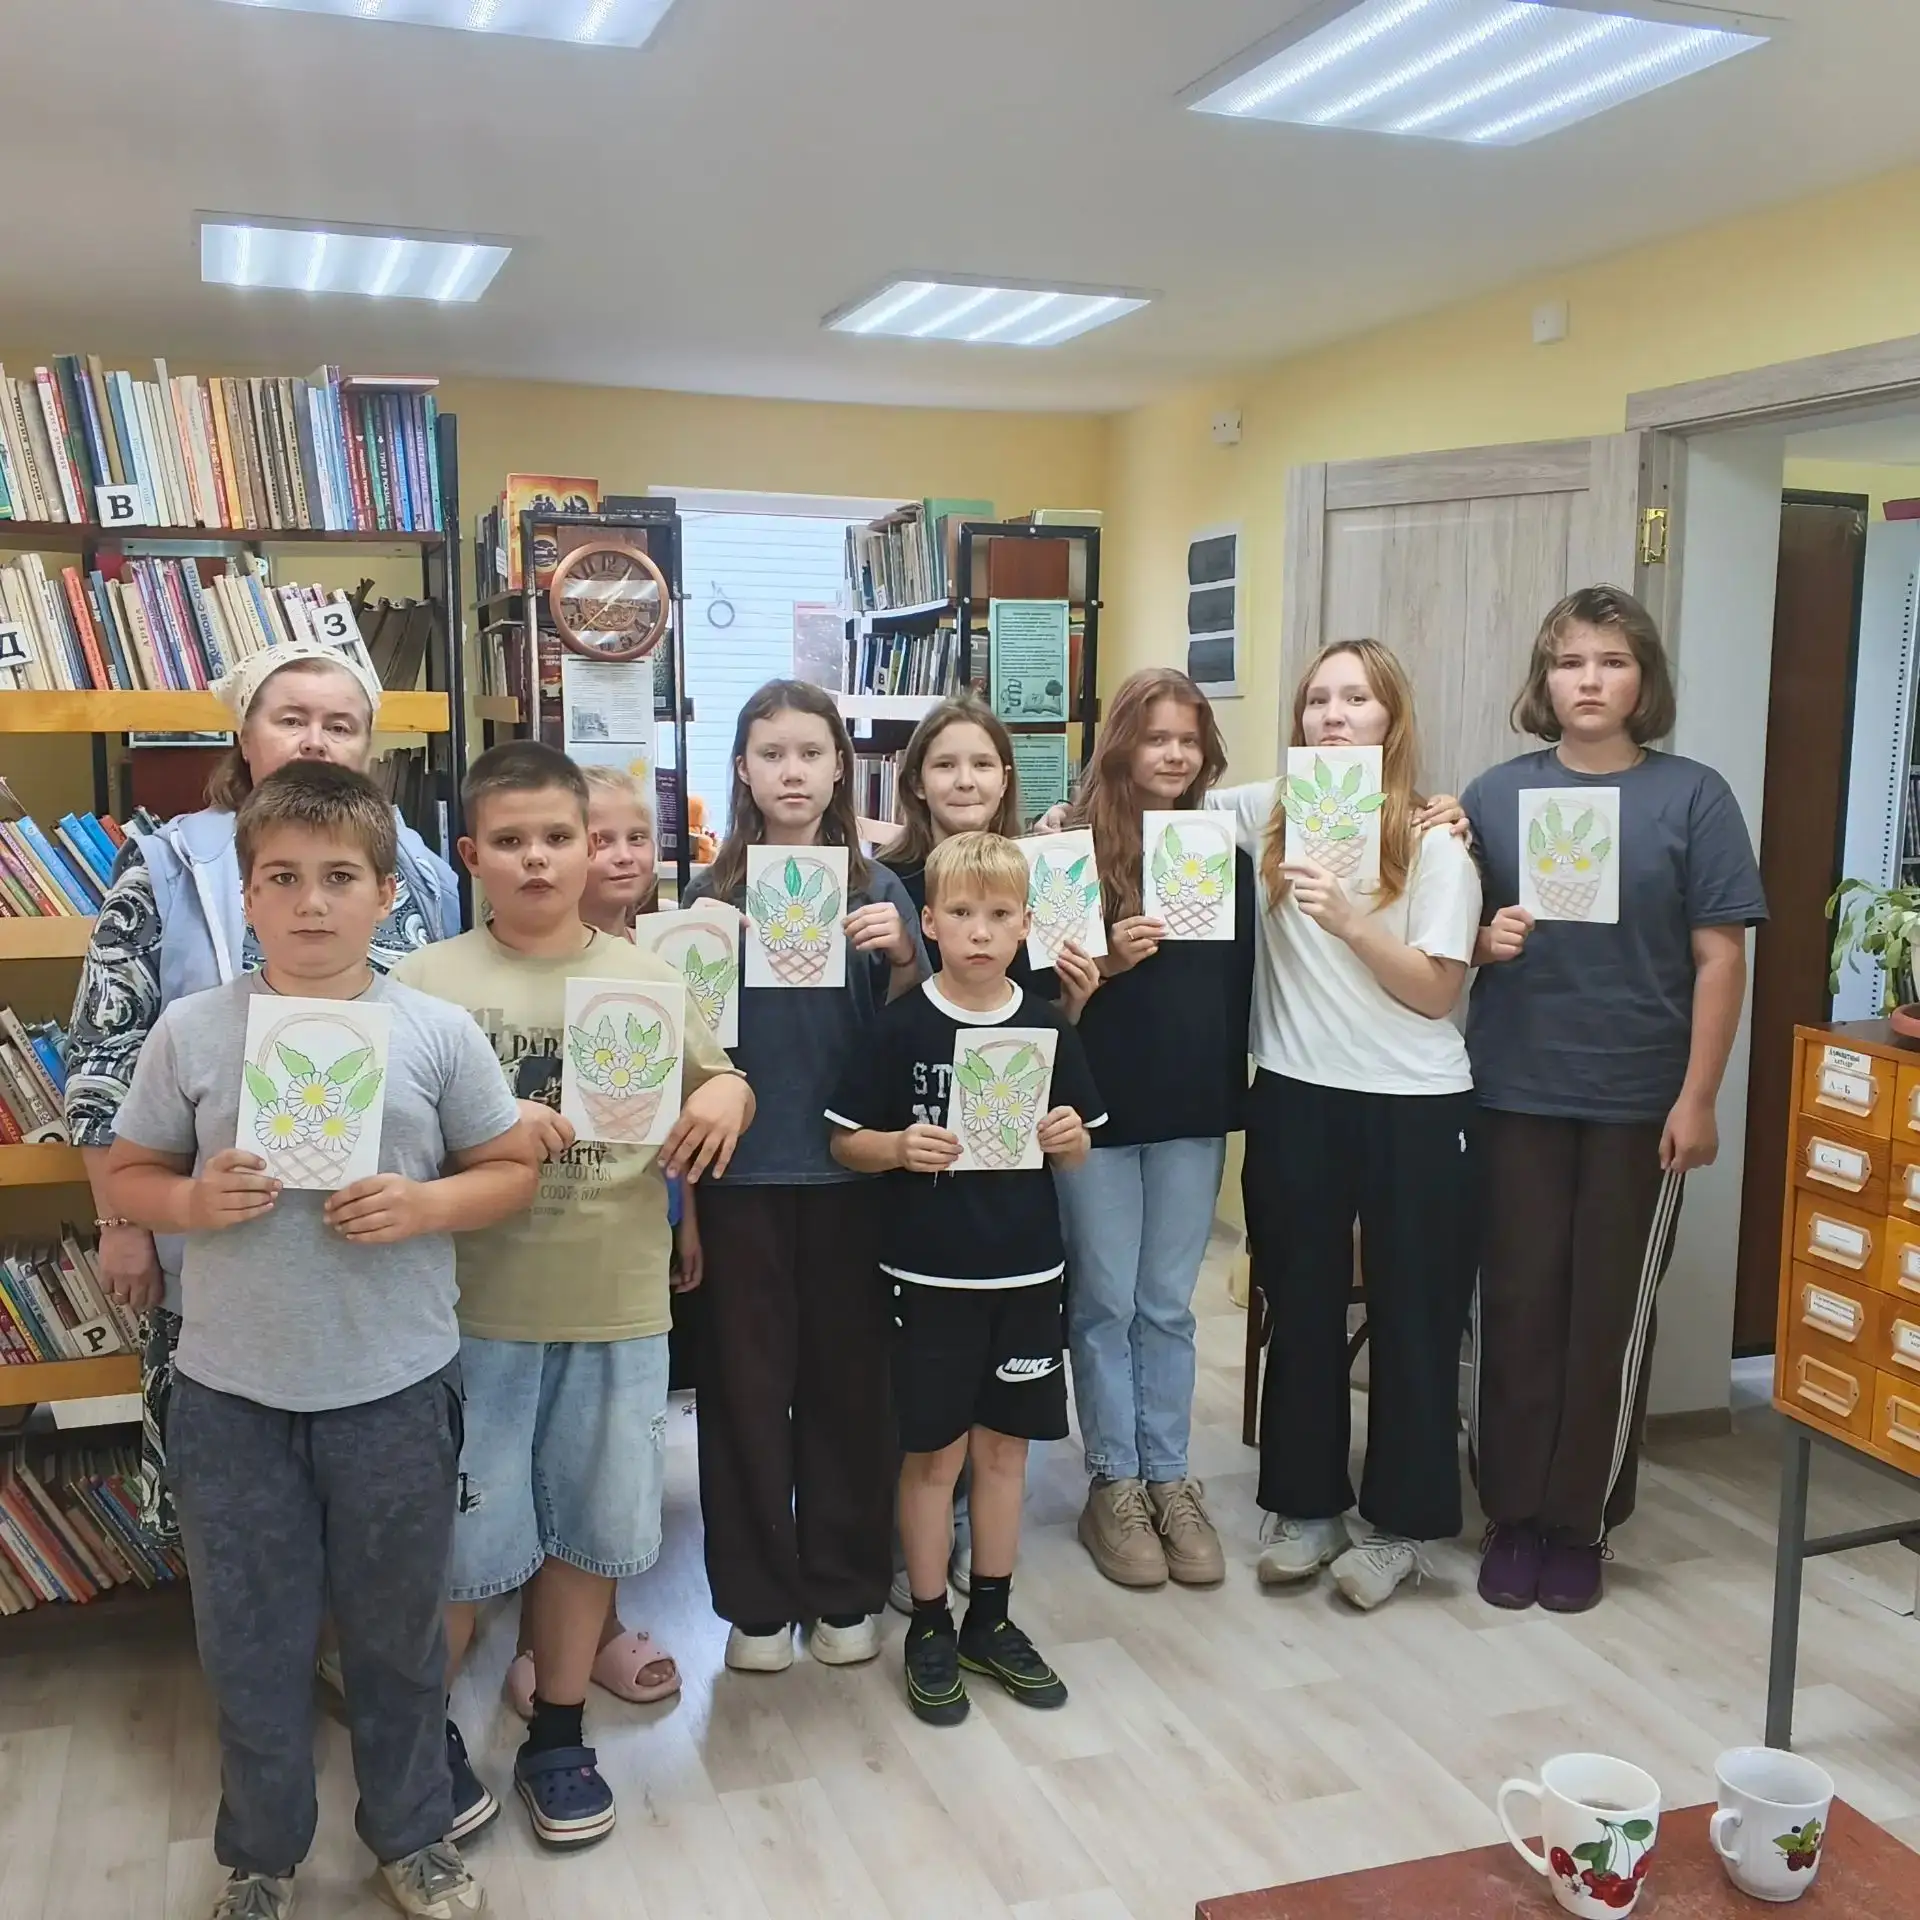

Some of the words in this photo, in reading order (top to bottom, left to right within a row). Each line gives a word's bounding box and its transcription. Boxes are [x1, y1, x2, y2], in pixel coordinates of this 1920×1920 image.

[108, 494, 134, 521] В
[323, 612, 347, 636] З
[0, 632, 26, 660] Д
[542, 1140, 607, 1172] arty
[82, 1326, 106, 1352] Р
[1005, 1357, 1052, 1373] NIKE
